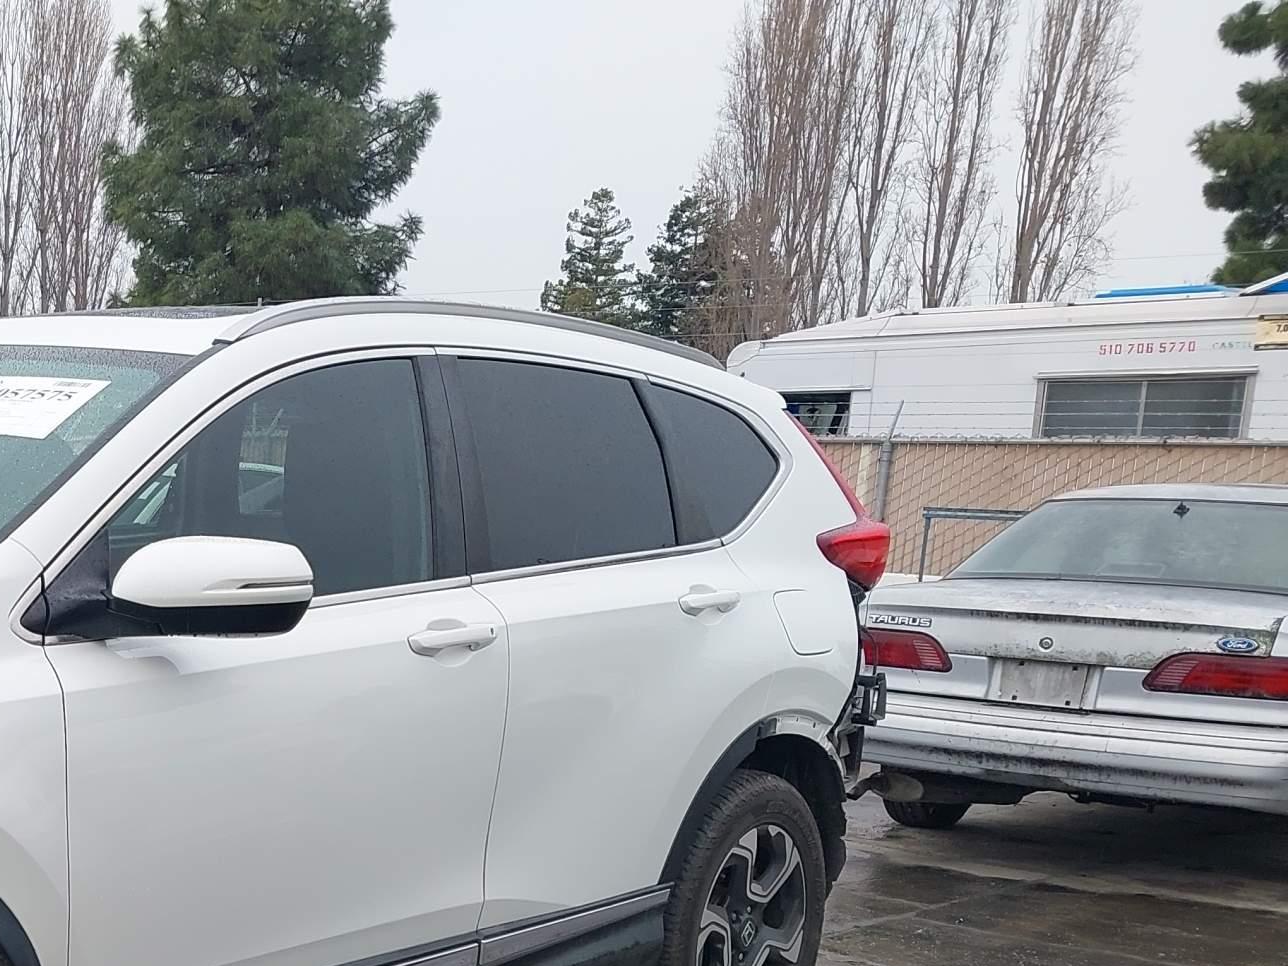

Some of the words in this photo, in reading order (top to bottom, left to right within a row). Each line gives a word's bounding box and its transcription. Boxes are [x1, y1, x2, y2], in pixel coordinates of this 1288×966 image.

[1099, 344, 1122, 356] 510
[1127, 342, 1154, 354] 706
[1159, 340, 1197, 353] 5770
[870, 614, 931, 627] TAURUS
